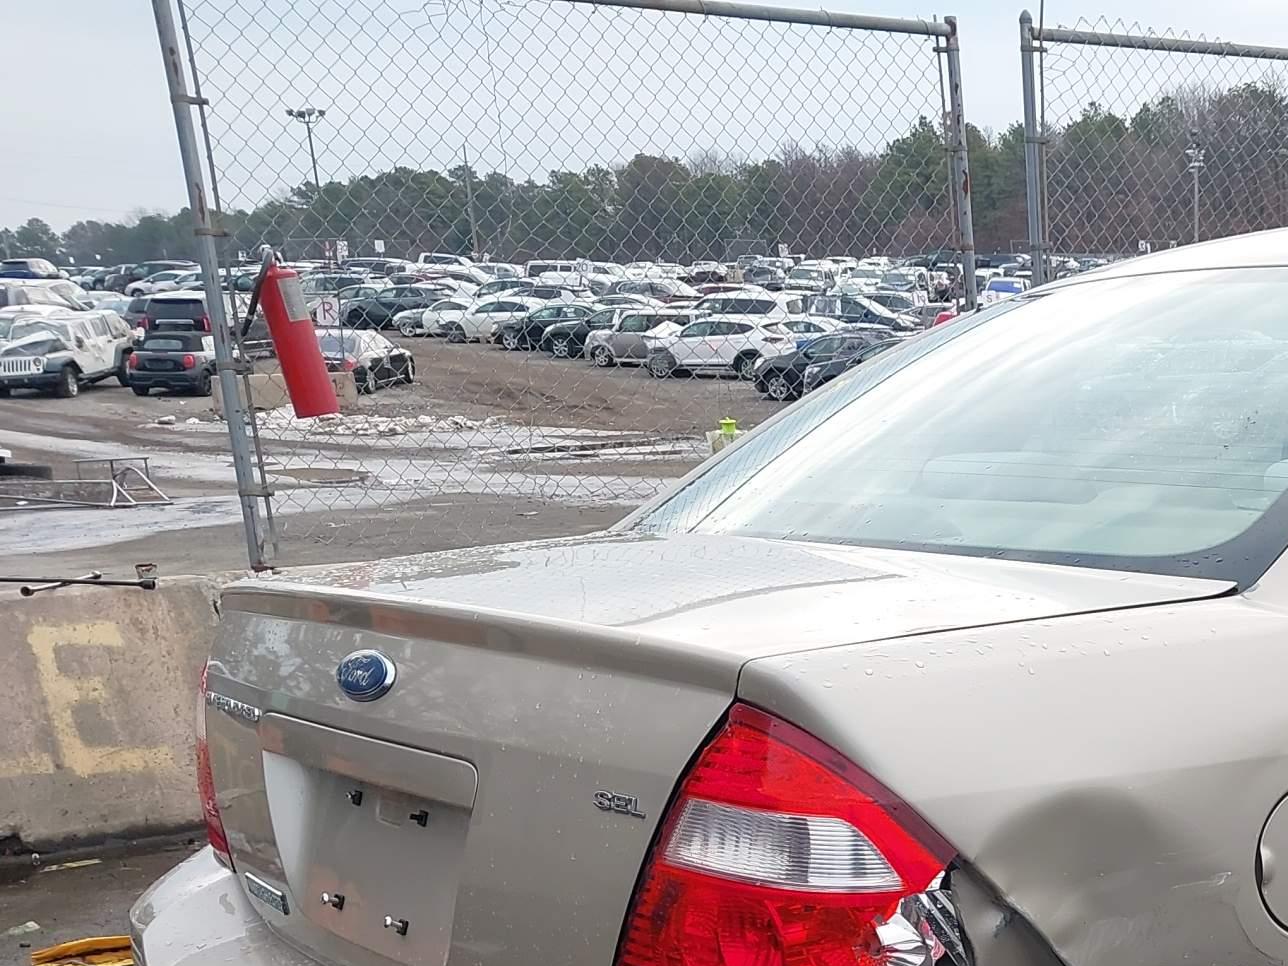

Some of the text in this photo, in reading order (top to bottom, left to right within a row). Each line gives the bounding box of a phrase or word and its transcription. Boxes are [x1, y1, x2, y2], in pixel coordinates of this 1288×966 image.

[322, 301, 336, 321] R
[27, 621, 173, 778] E
[593, 790, 646, 819] SEL
